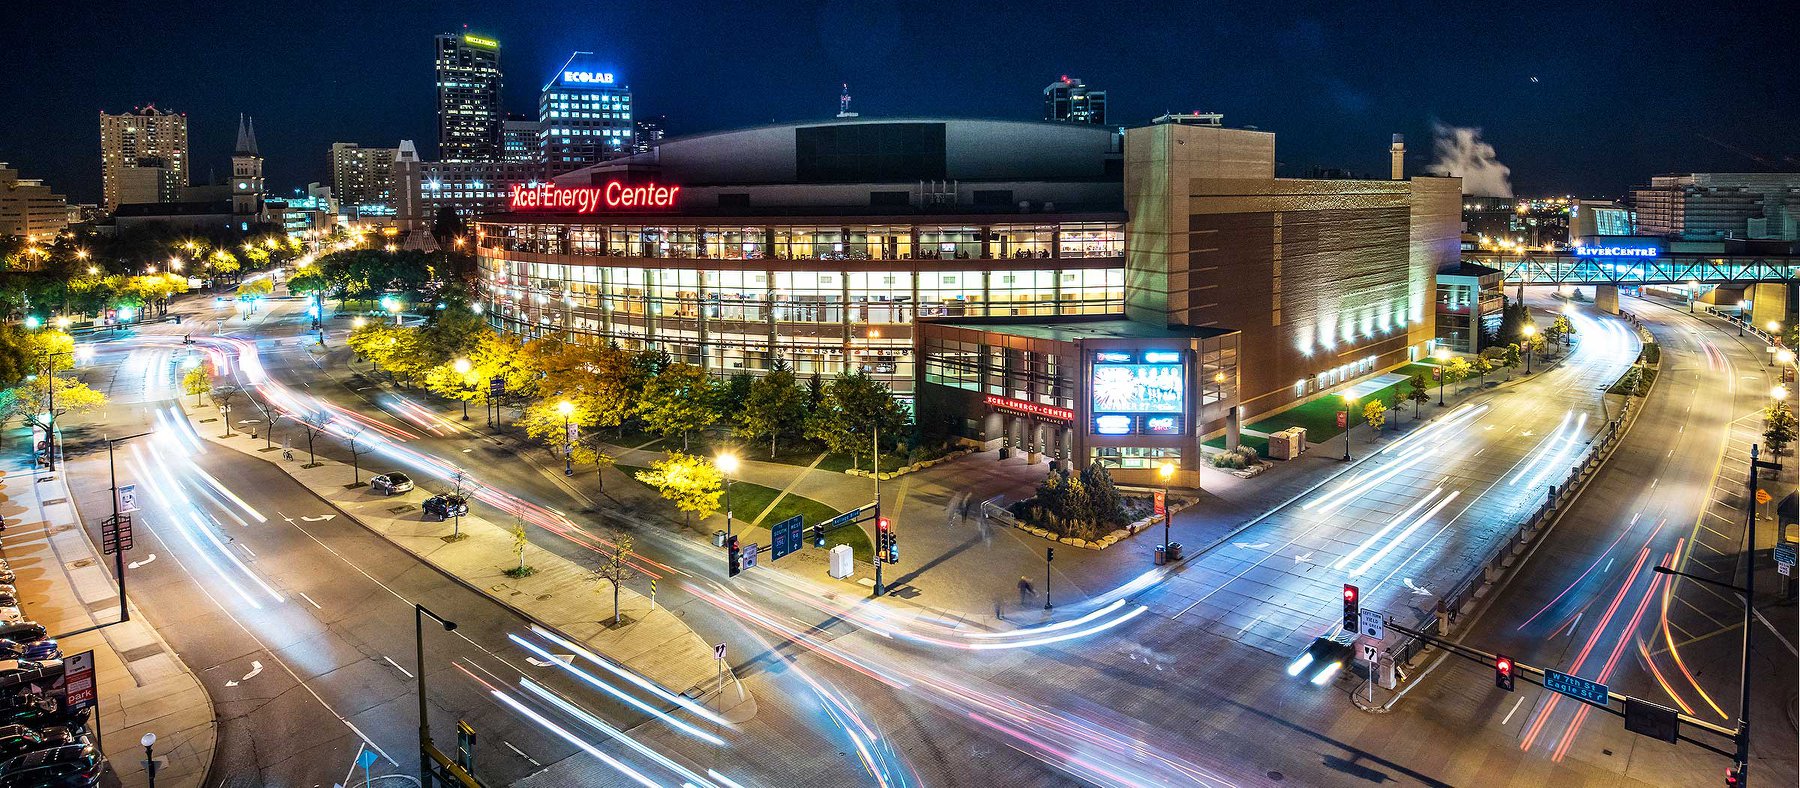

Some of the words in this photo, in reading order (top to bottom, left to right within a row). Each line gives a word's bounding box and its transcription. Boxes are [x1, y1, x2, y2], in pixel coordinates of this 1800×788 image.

[564, 71, 614, 83] ECOLAB
[512, 184, 541, 207] Xcel
[544, 182, 600, 213] Energy
[606, 181, 679, 206] Center
[987, 396, 1005, 406] XCEL
[1010, 400, 1038, 412] ENERGY
[1043, 407, 1073, 419] CENTER
[1036, 416, 1064, 425] ENTRANCE
[1547, 679, 1577, 693] Eagle
[1580, 689, 1593, 698] St
[1552, 672, 1560, 680] W
[1564, 675, 1580, 687] 7th
[1584, 681, 1596, 691] St
[68, 690, 91, 704] park
